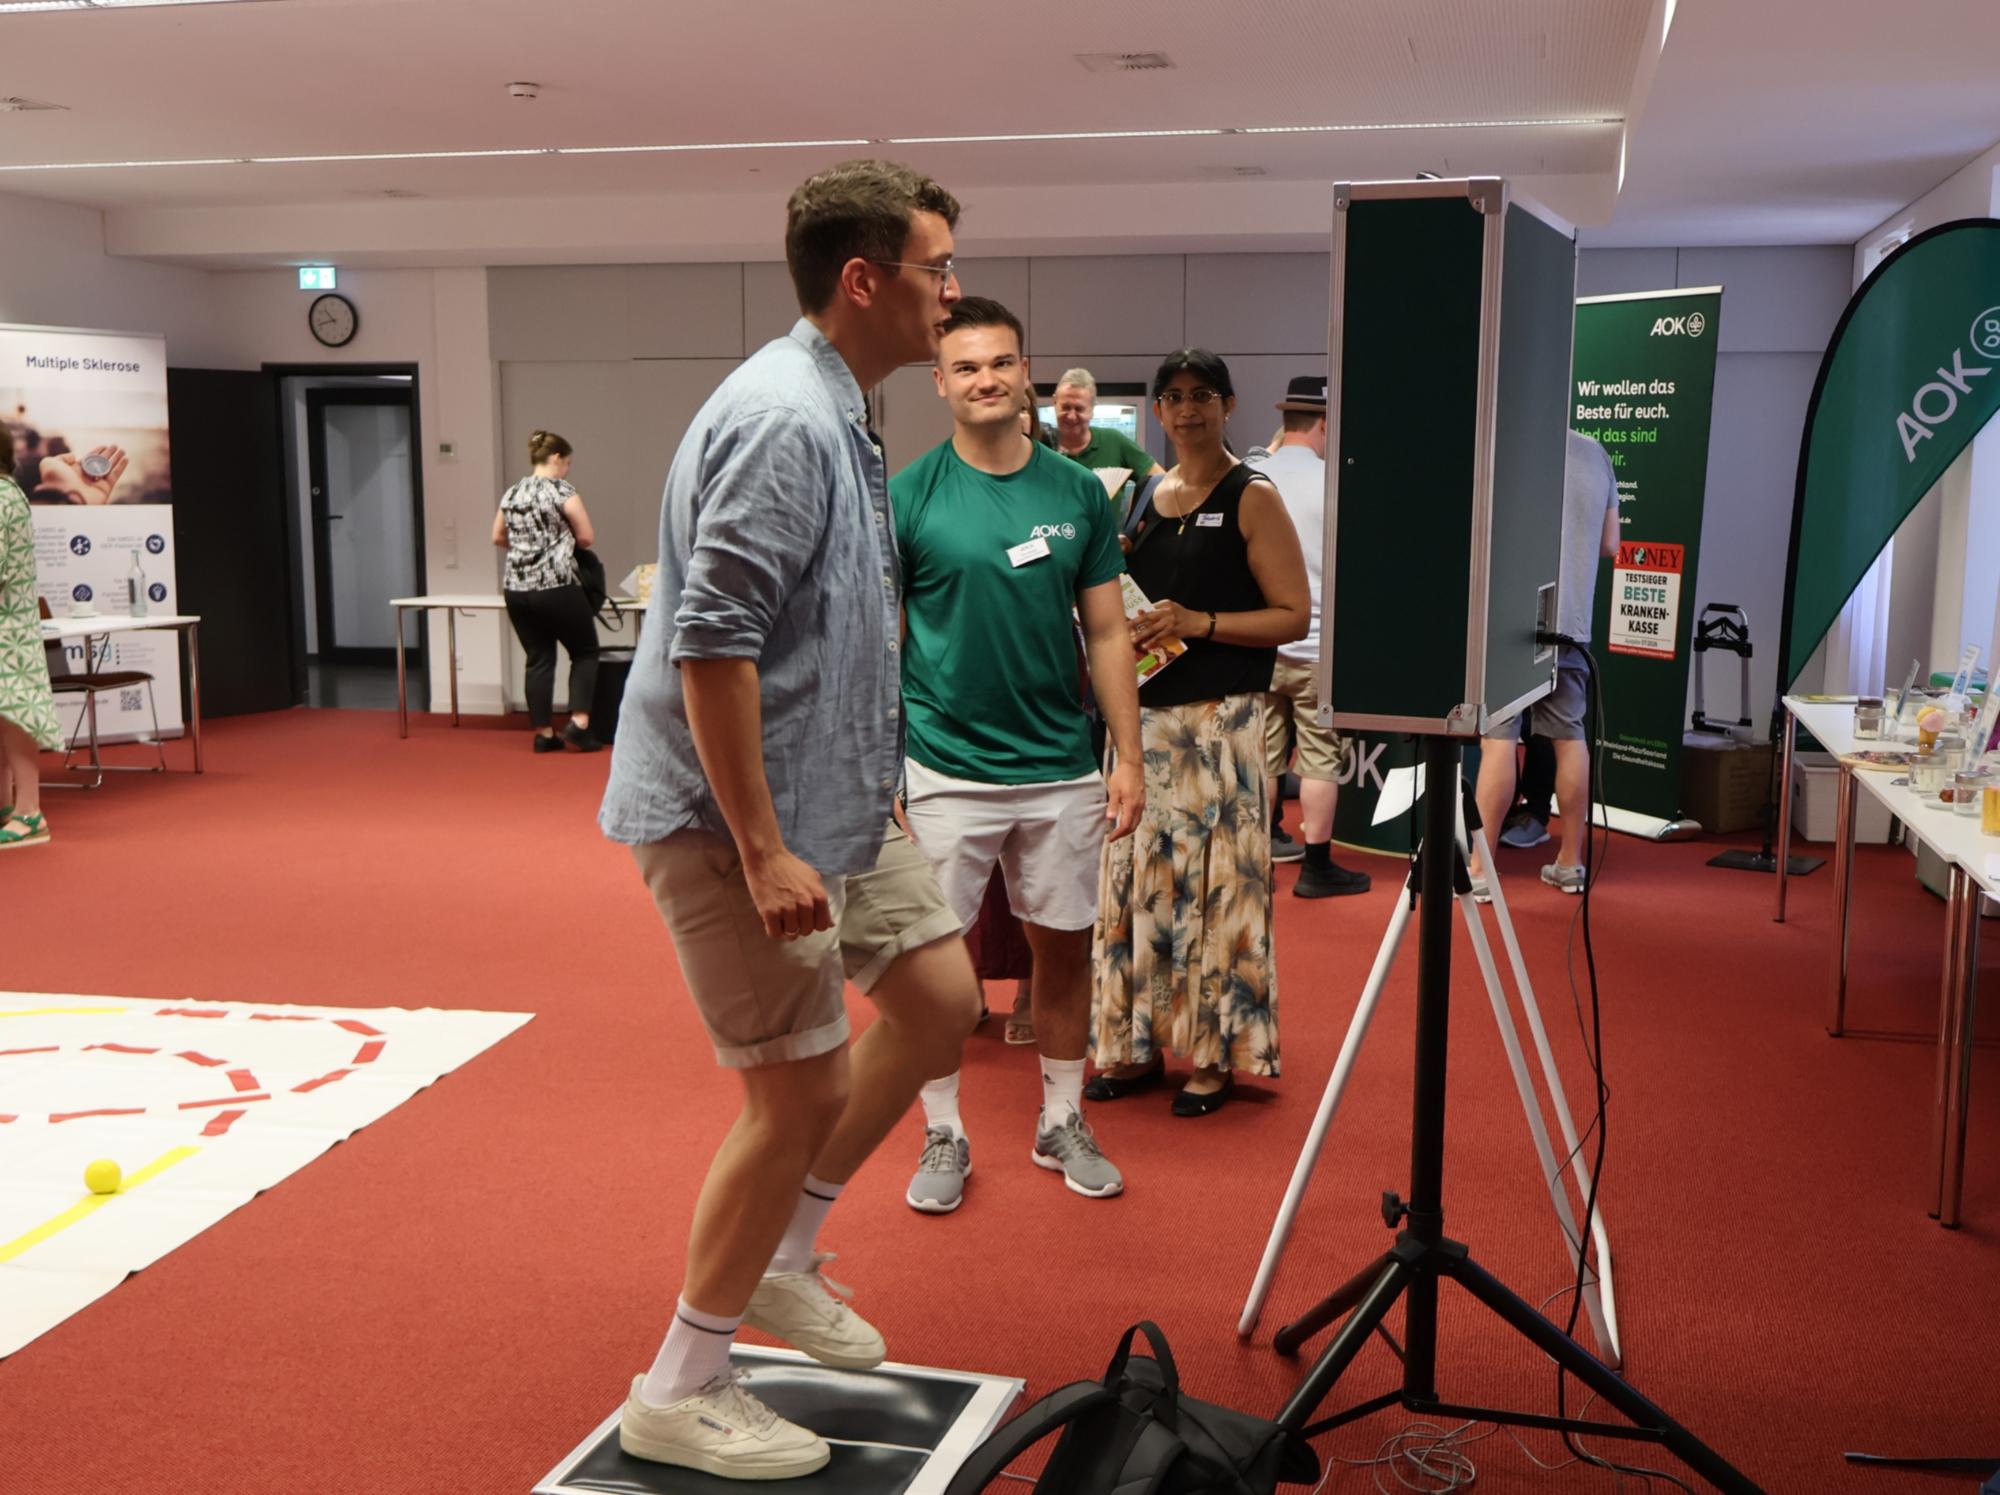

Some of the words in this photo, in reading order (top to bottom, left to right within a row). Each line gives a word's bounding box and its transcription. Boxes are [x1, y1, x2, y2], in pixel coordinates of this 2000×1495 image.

[1650, 316, 1686, 336] AOK
[26, 355, 80, 371] Multiple
[82, 358, 141, 373] Sklerose
[1577, 380, 1600, 396] Wir
[1602, 379, 1646, 395] wollen
[1649, 379, 1675, 394] das
[1576, 404, 1611, 419] Beste
[1614, 403, 1633, 419] für
[1635, 403, 1669, 418] euch.
[1896, 348, 1992, 464] AOK
[1603, 428, 1627, 442] das
[1630, 427, 1657, 442] sind
[1030, 524, 1061, 538] AOK
[1625, 573, 1668, 585] TESTSIEGER
[1624, 586, 1666, 603] BESTE
[1620, 603, 1669, 620] KRANKEN-
[1628, 620, 1659, 635] KASSE
[63, 644, 112, 662] msg
[1337, 739, 1388, 792] OK
